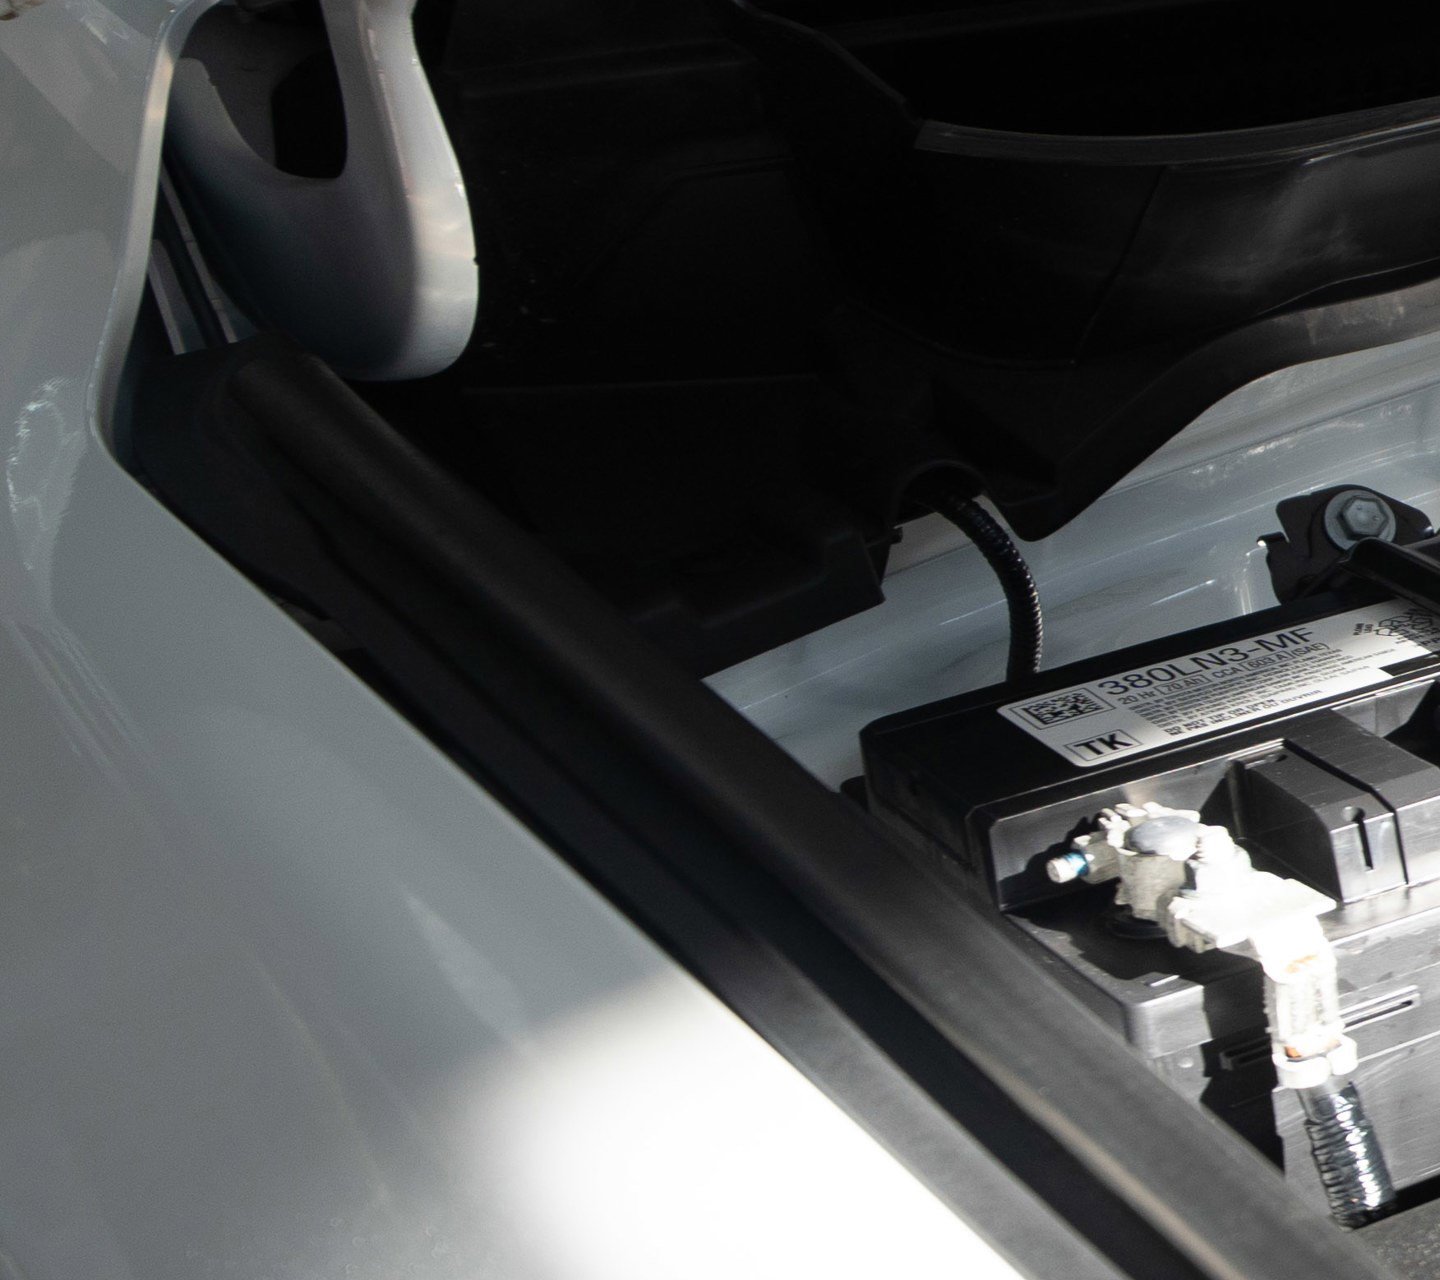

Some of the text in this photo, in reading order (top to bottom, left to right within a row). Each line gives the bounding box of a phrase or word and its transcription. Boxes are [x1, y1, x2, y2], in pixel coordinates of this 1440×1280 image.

[1098, 627, 1315, 696] 380LN3-MF
[1117, 641, 1332, 705] 20 Hr 70 Ah CCA 603 A (SAE)
[1074, 732, 1133, 756] TK
